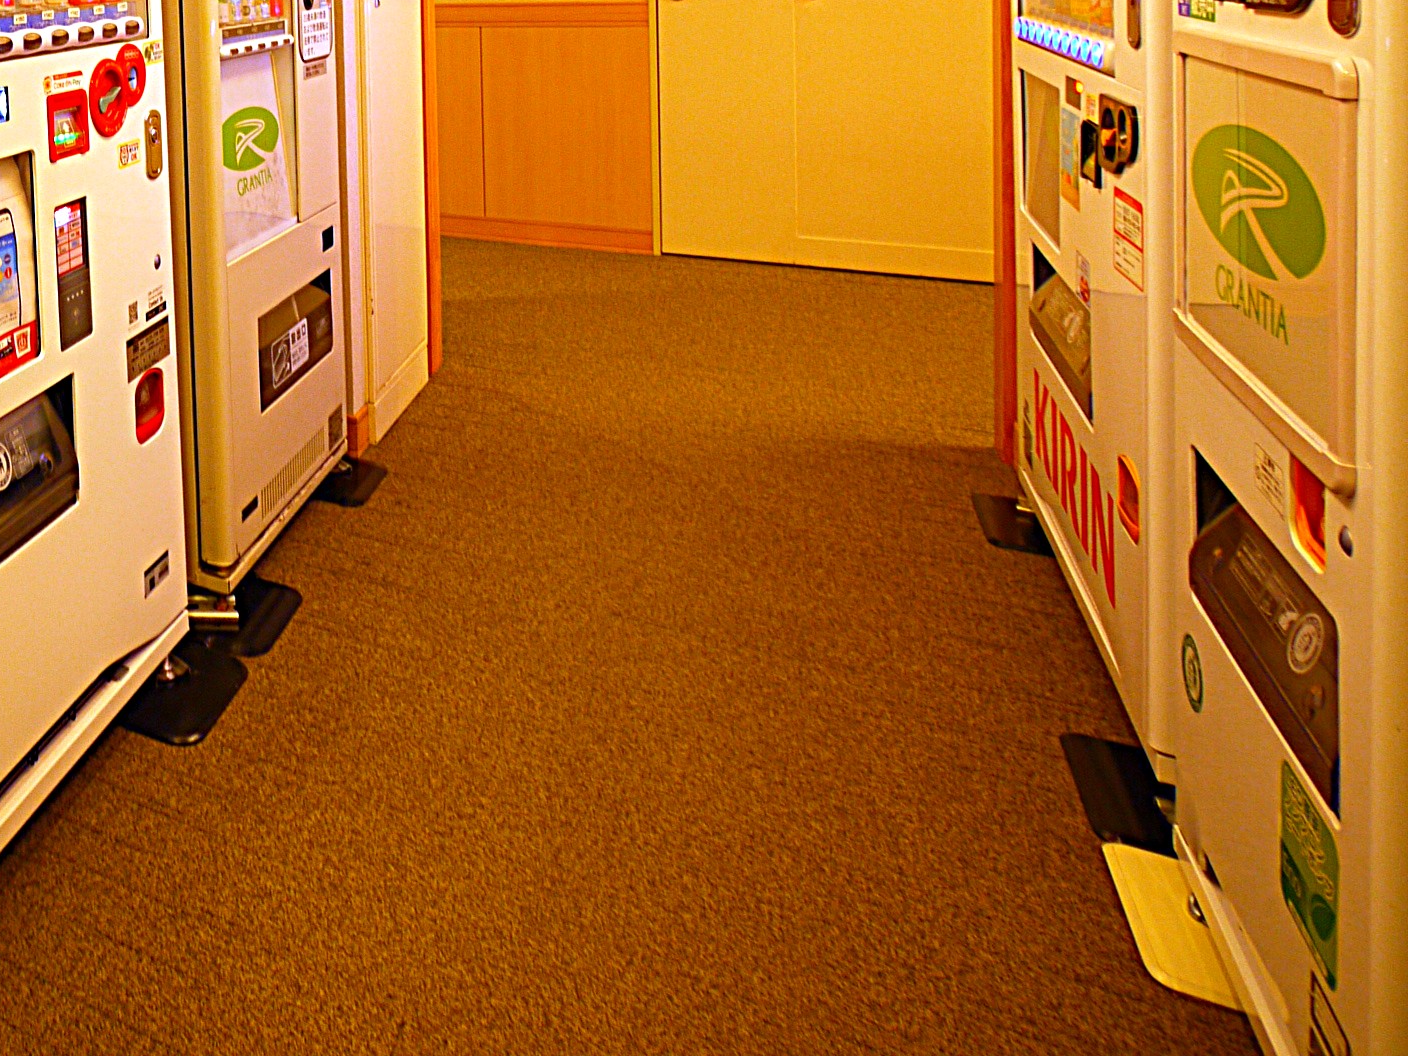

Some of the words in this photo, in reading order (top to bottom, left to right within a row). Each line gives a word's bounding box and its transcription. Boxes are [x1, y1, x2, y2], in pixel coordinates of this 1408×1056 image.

[237, 167, 274, 197] GRANTIA
[1215, 264, 1290, 346] GRANTIA
[1033, 366, 1116, 610] KIRIN
